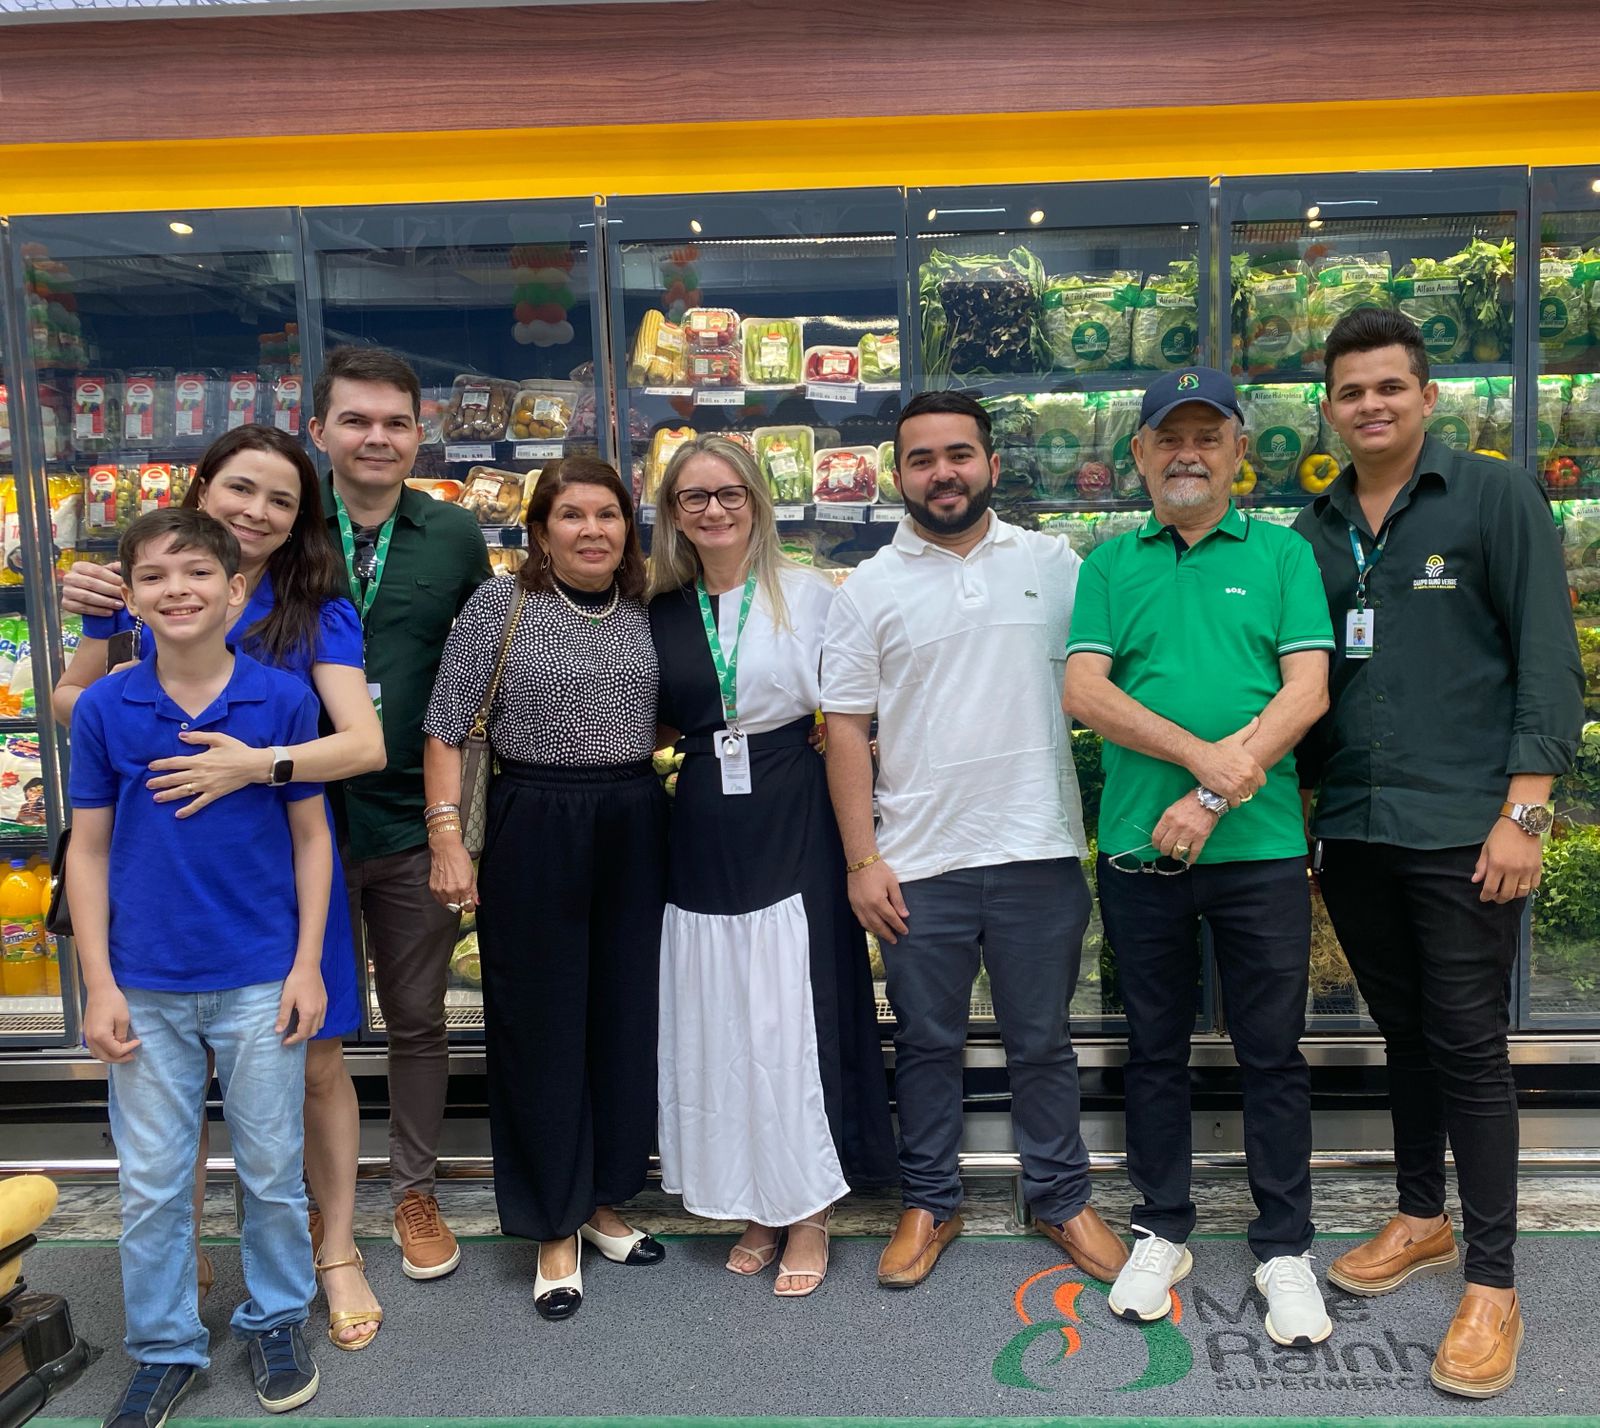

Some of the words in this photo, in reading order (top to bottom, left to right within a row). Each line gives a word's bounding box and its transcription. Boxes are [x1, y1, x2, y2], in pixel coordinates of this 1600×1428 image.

[1416, 284, 1435, 294] Alface
[1254, 392, 1272, 400] Alface
[1441, 578, 1458, 586] VERDE
[1225, 587, 1247, 596] BOSS
[1192, 1286, 1372, 1324] Me
[1205, 1330, 1438, 1374] Rainh
